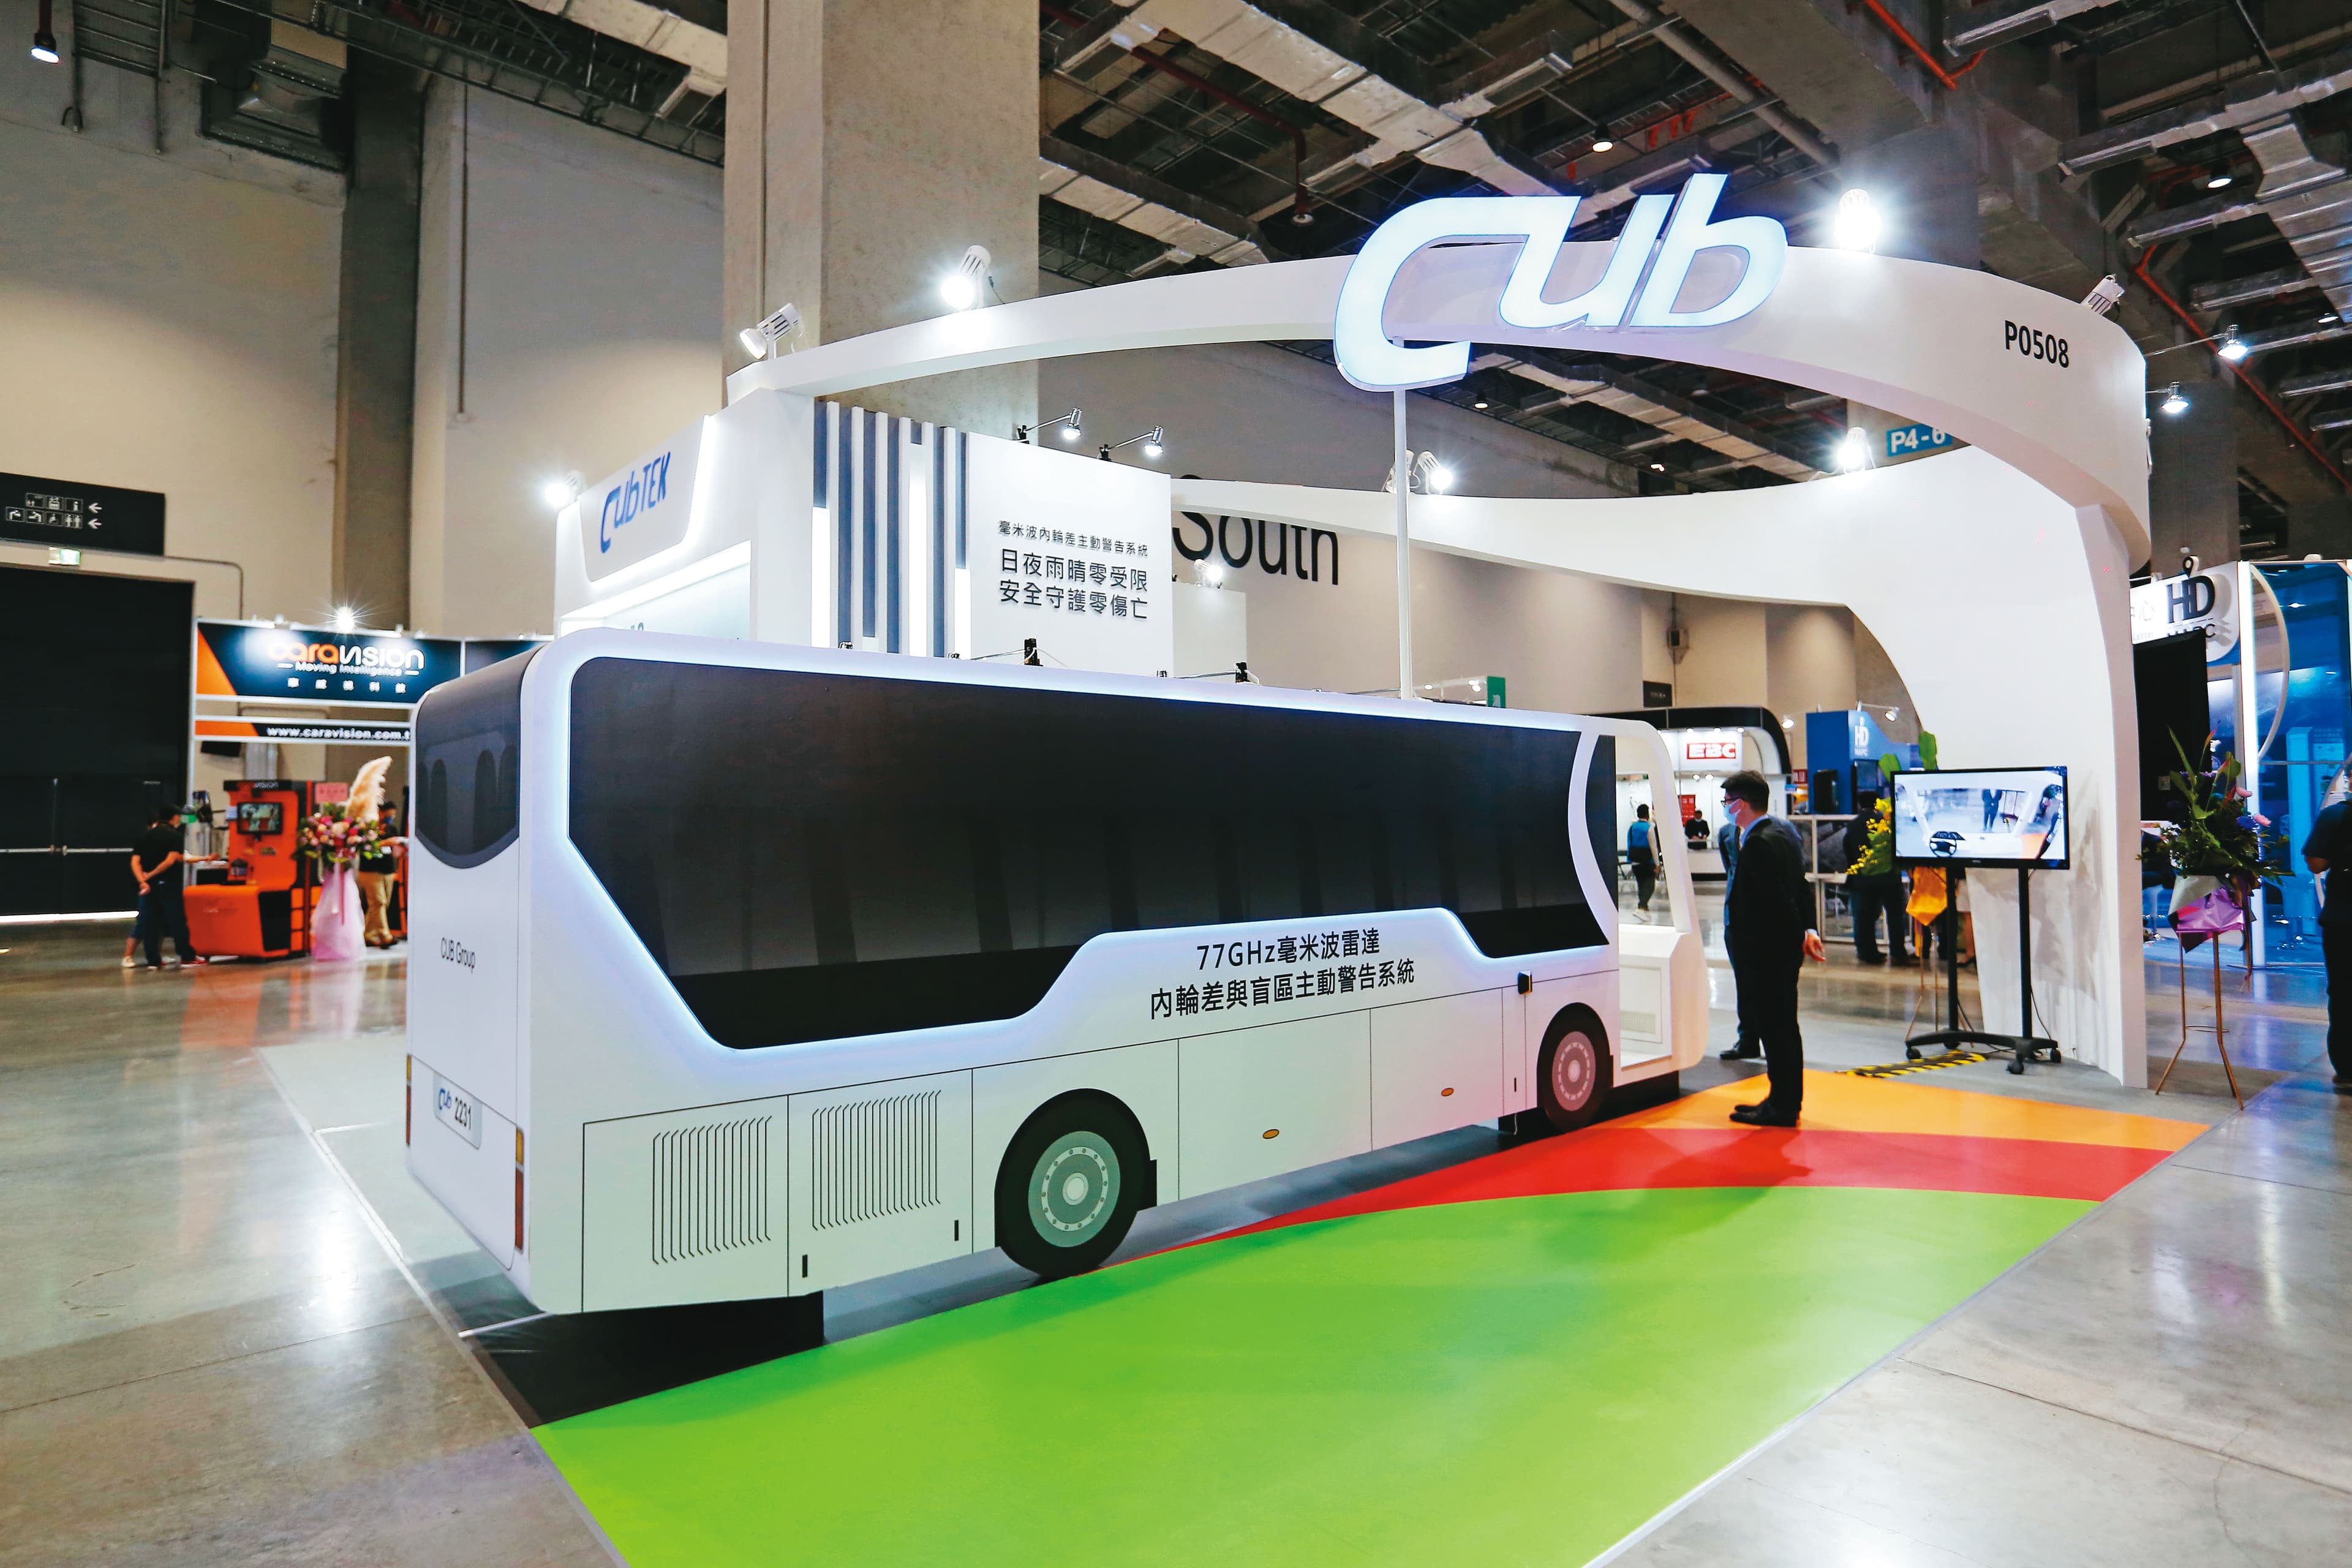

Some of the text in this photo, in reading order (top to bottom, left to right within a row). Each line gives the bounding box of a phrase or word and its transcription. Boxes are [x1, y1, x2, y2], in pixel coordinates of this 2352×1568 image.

[2004, 320, 2069, 368] P0508
[1890, 428, 1946, 453] P4-6
[999, 520, 1148, 557] 毫米波內輪差主動警告系統
[1001, 548, 1148, 592] 日夜雨晴零受限
[1000, 579, 1148, 619] 安全守護零傷亡
[295, 661, 402, 677] Moving Intelligence
[1688, 743, 1736, 758] EBC
[440, 937, 476, 975] CUB Group
[1197, 927, 1380, 970] 77GHz毫米波雷達
[1150, 958, 1415, 1020] 內輪差與盲區主動警告系統
[454, 1096, 472, 1131] 2231
